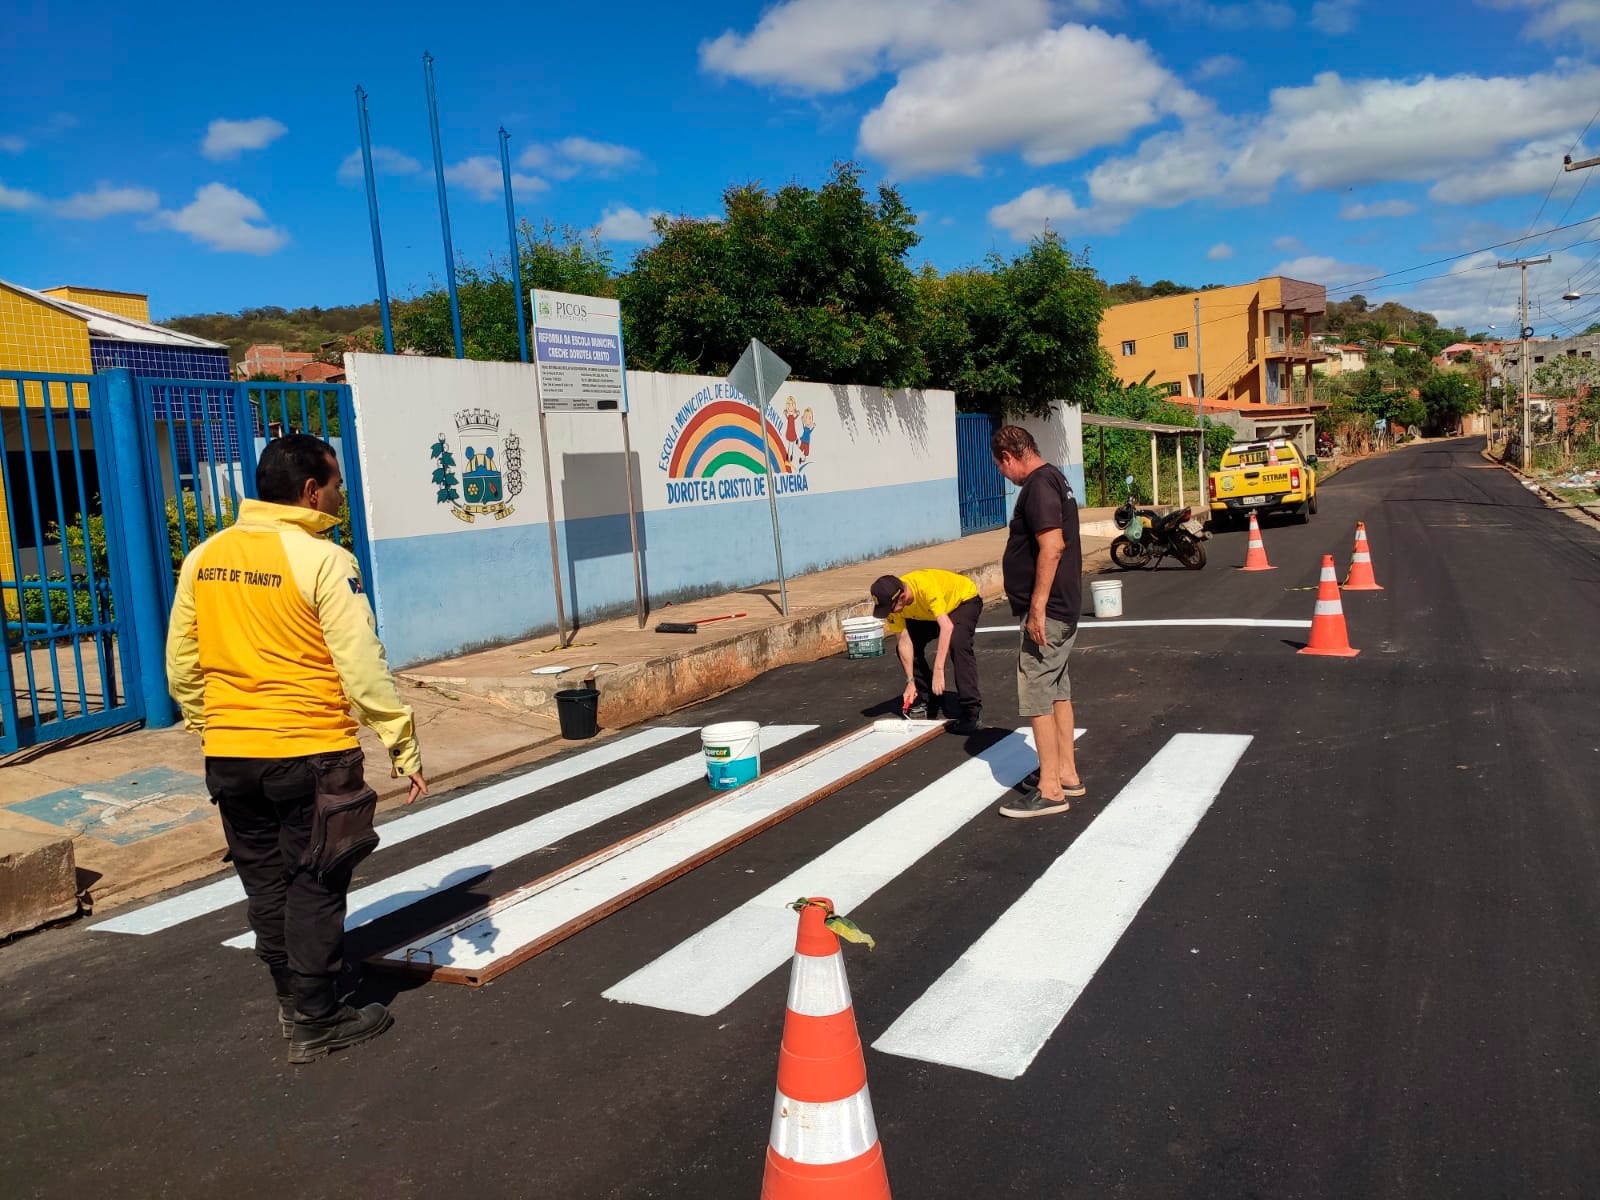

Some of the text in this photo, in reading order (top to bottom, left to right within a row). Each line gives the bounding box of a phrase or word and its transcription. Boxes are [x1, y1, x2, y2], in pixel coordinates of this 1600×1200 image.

[556, 301, 587, 318] PICOS
[563, 334, 572, 345] DA
[571, 335, 591, 347] ESCOLA
[591, 337, 616, 349] MUNICIPAL
[548, 347, 610, 362] CRECHE DOROTEA CRISTO
[658, 424, 681, 472] ESCOLA
[674, 384, 713, 430] MUNICIPAL
[714, 384, 723, 399] DE
[1239, 451, 1268, 463] STTRA
[1262, 472, 1288, 482] STTRAM
[665, 474, 809, 504] DOROTEA CRISTO DE LIVEIRA
[229, 569, 242, 583] DE
